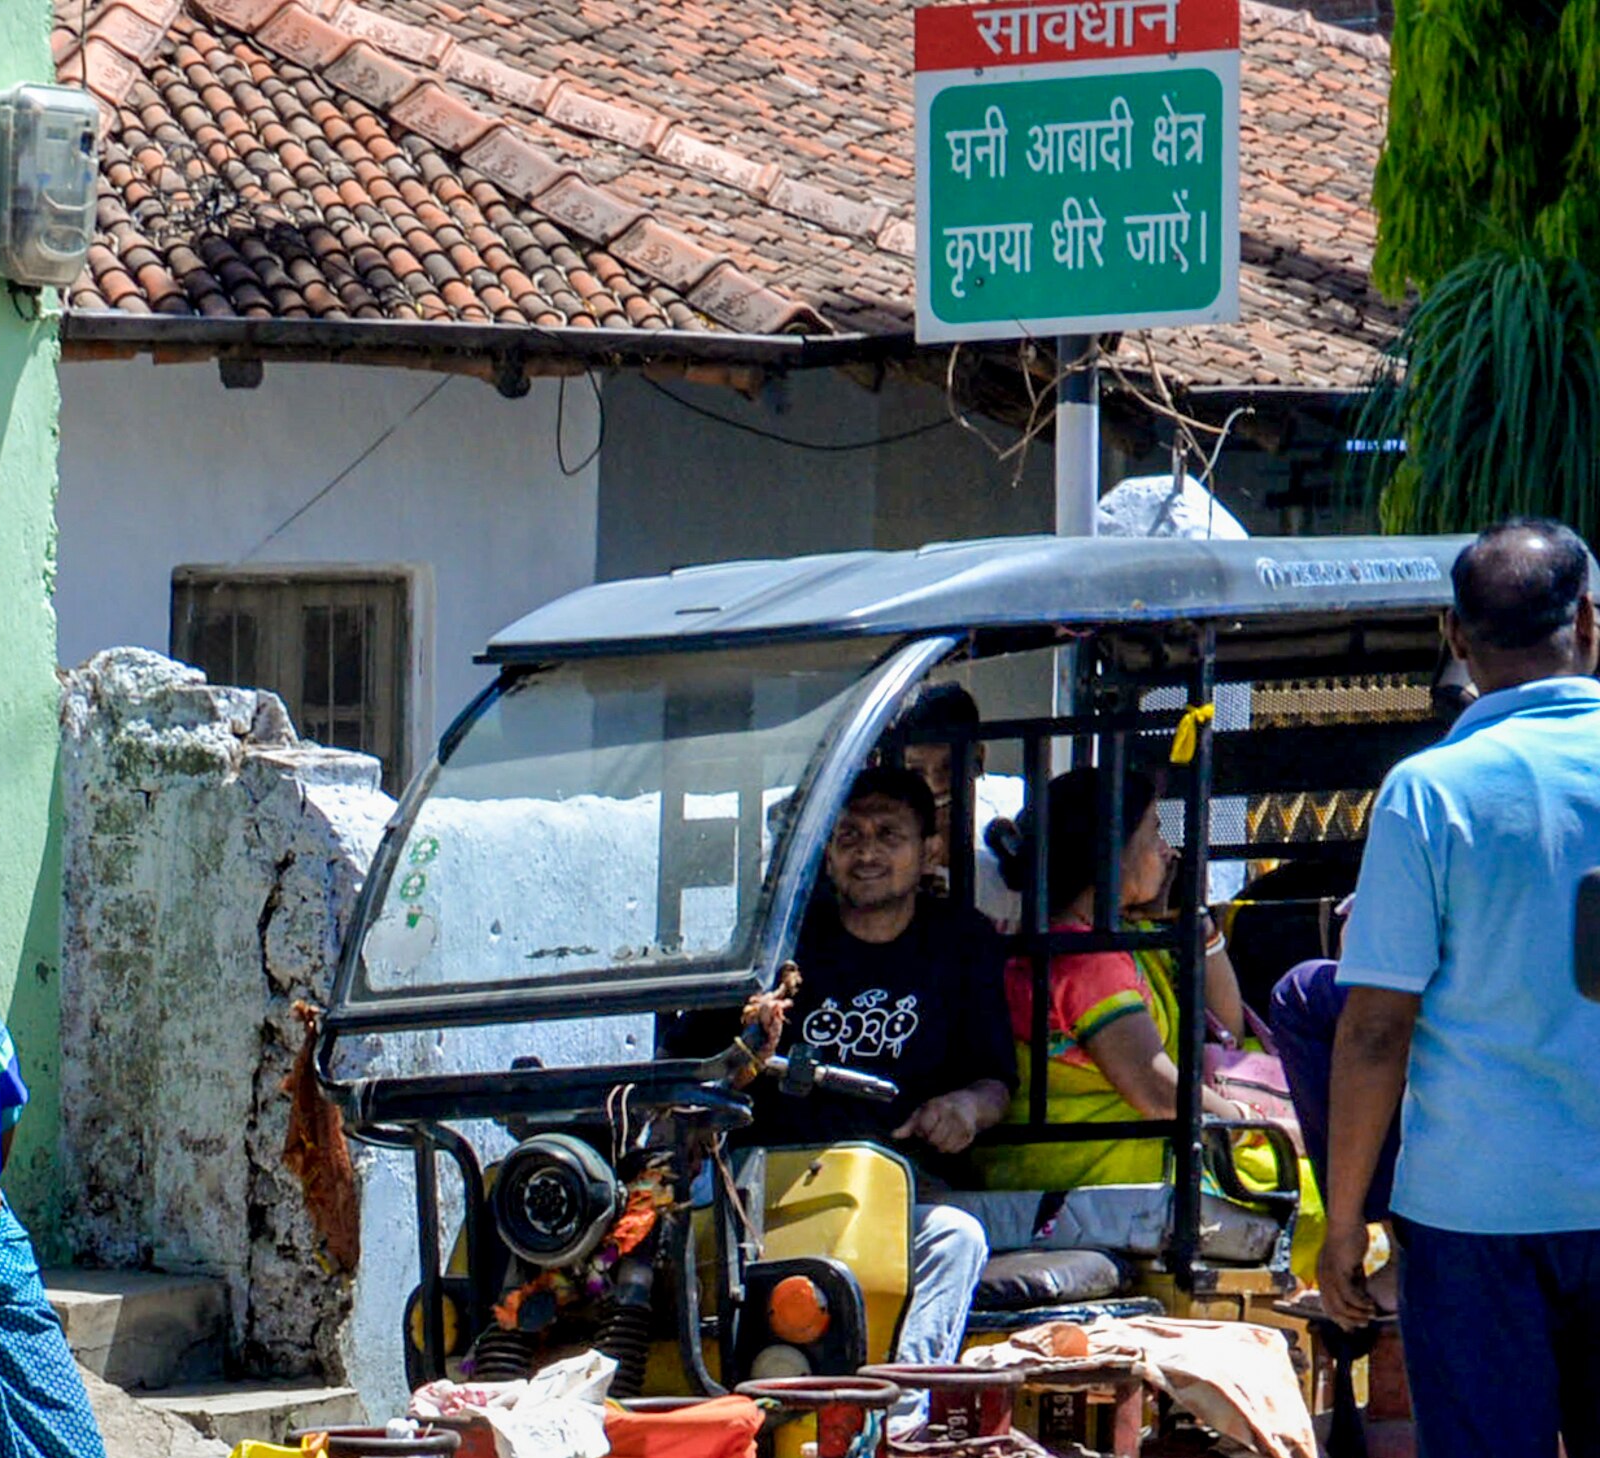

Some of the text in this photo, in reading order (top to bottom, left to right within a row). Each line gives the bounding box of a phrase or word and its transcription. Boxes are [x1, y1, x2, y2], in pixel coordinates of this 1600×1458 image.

[972, 0, 1180, 55] सावधान
[946, 94, 1206, 180] घनी आबादी क्षेत्र
[943, 222, 1033, 298] कृपया
[1051, 197, 1106, 270] धीरे
